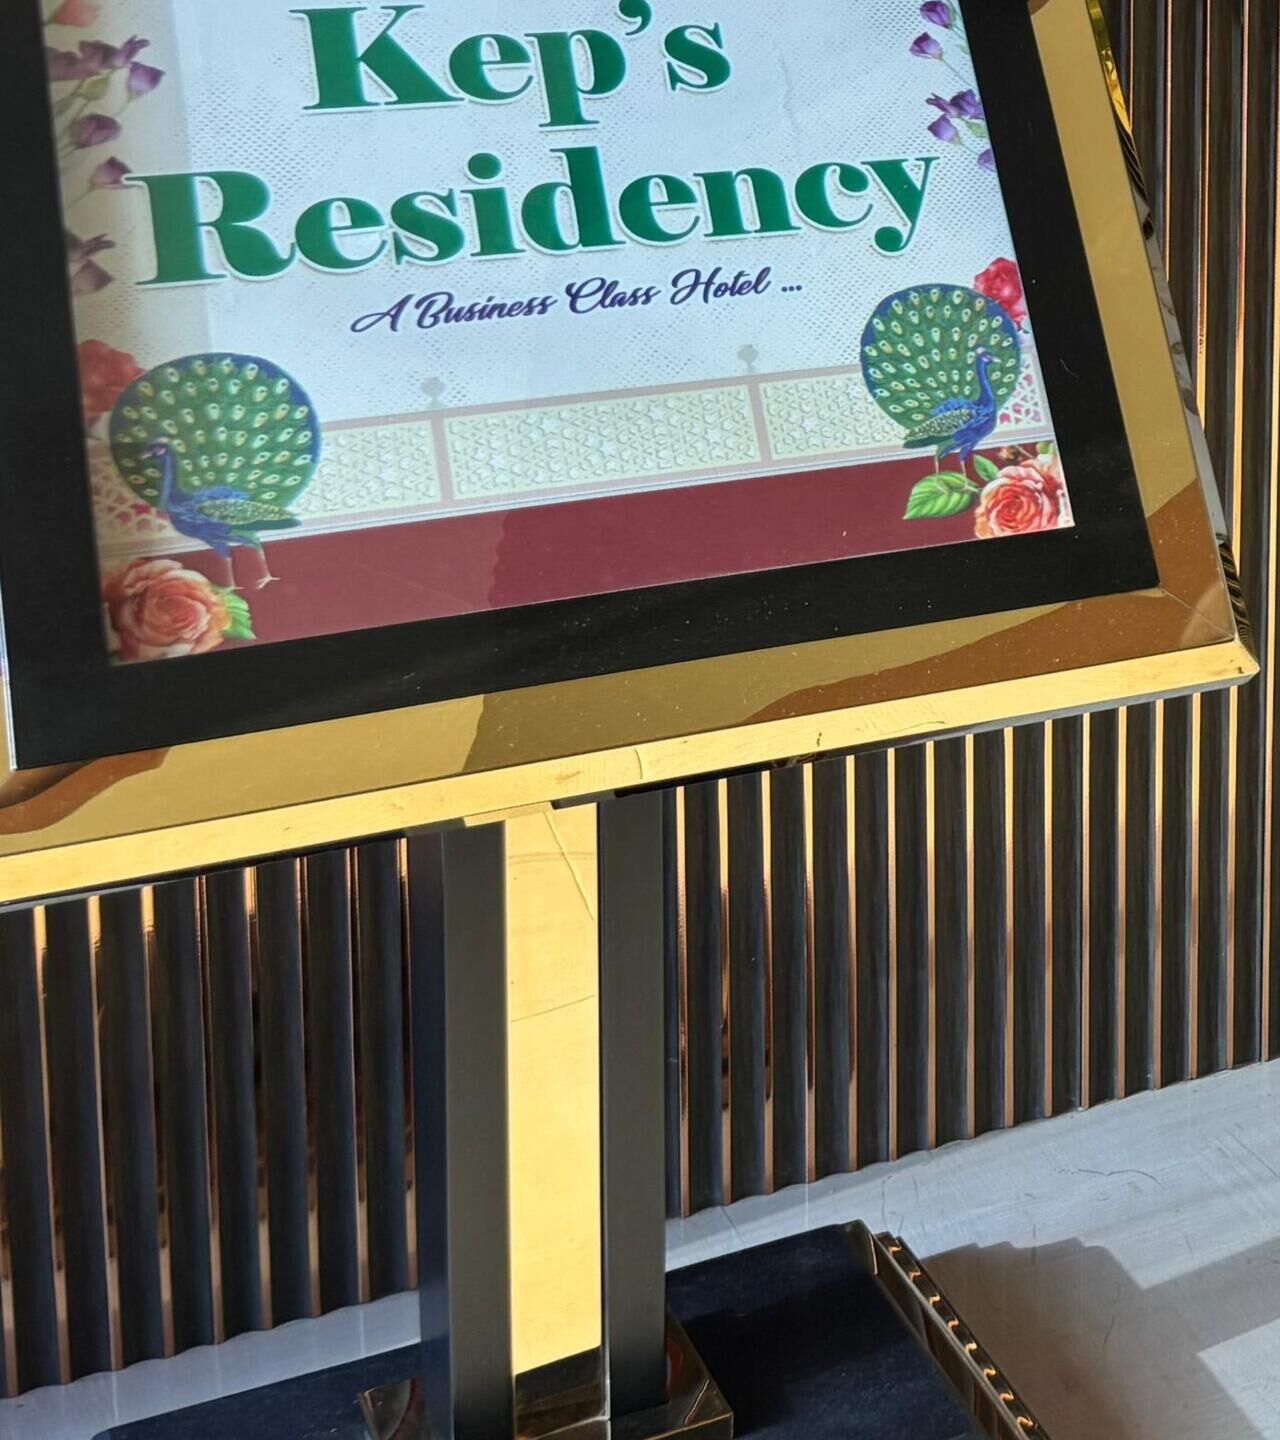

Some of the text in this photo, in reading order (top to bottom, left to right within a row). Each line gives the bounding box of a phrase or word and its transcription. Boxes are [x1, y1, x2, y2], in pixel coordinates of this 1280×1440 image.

[124, 145, 940, 287] Residency
[349, 293, 414, 333] A
[414, 290, 556, 329] Business
[565, 276, 661, 314] Class
[670, 266, 772, 305] Hotel
